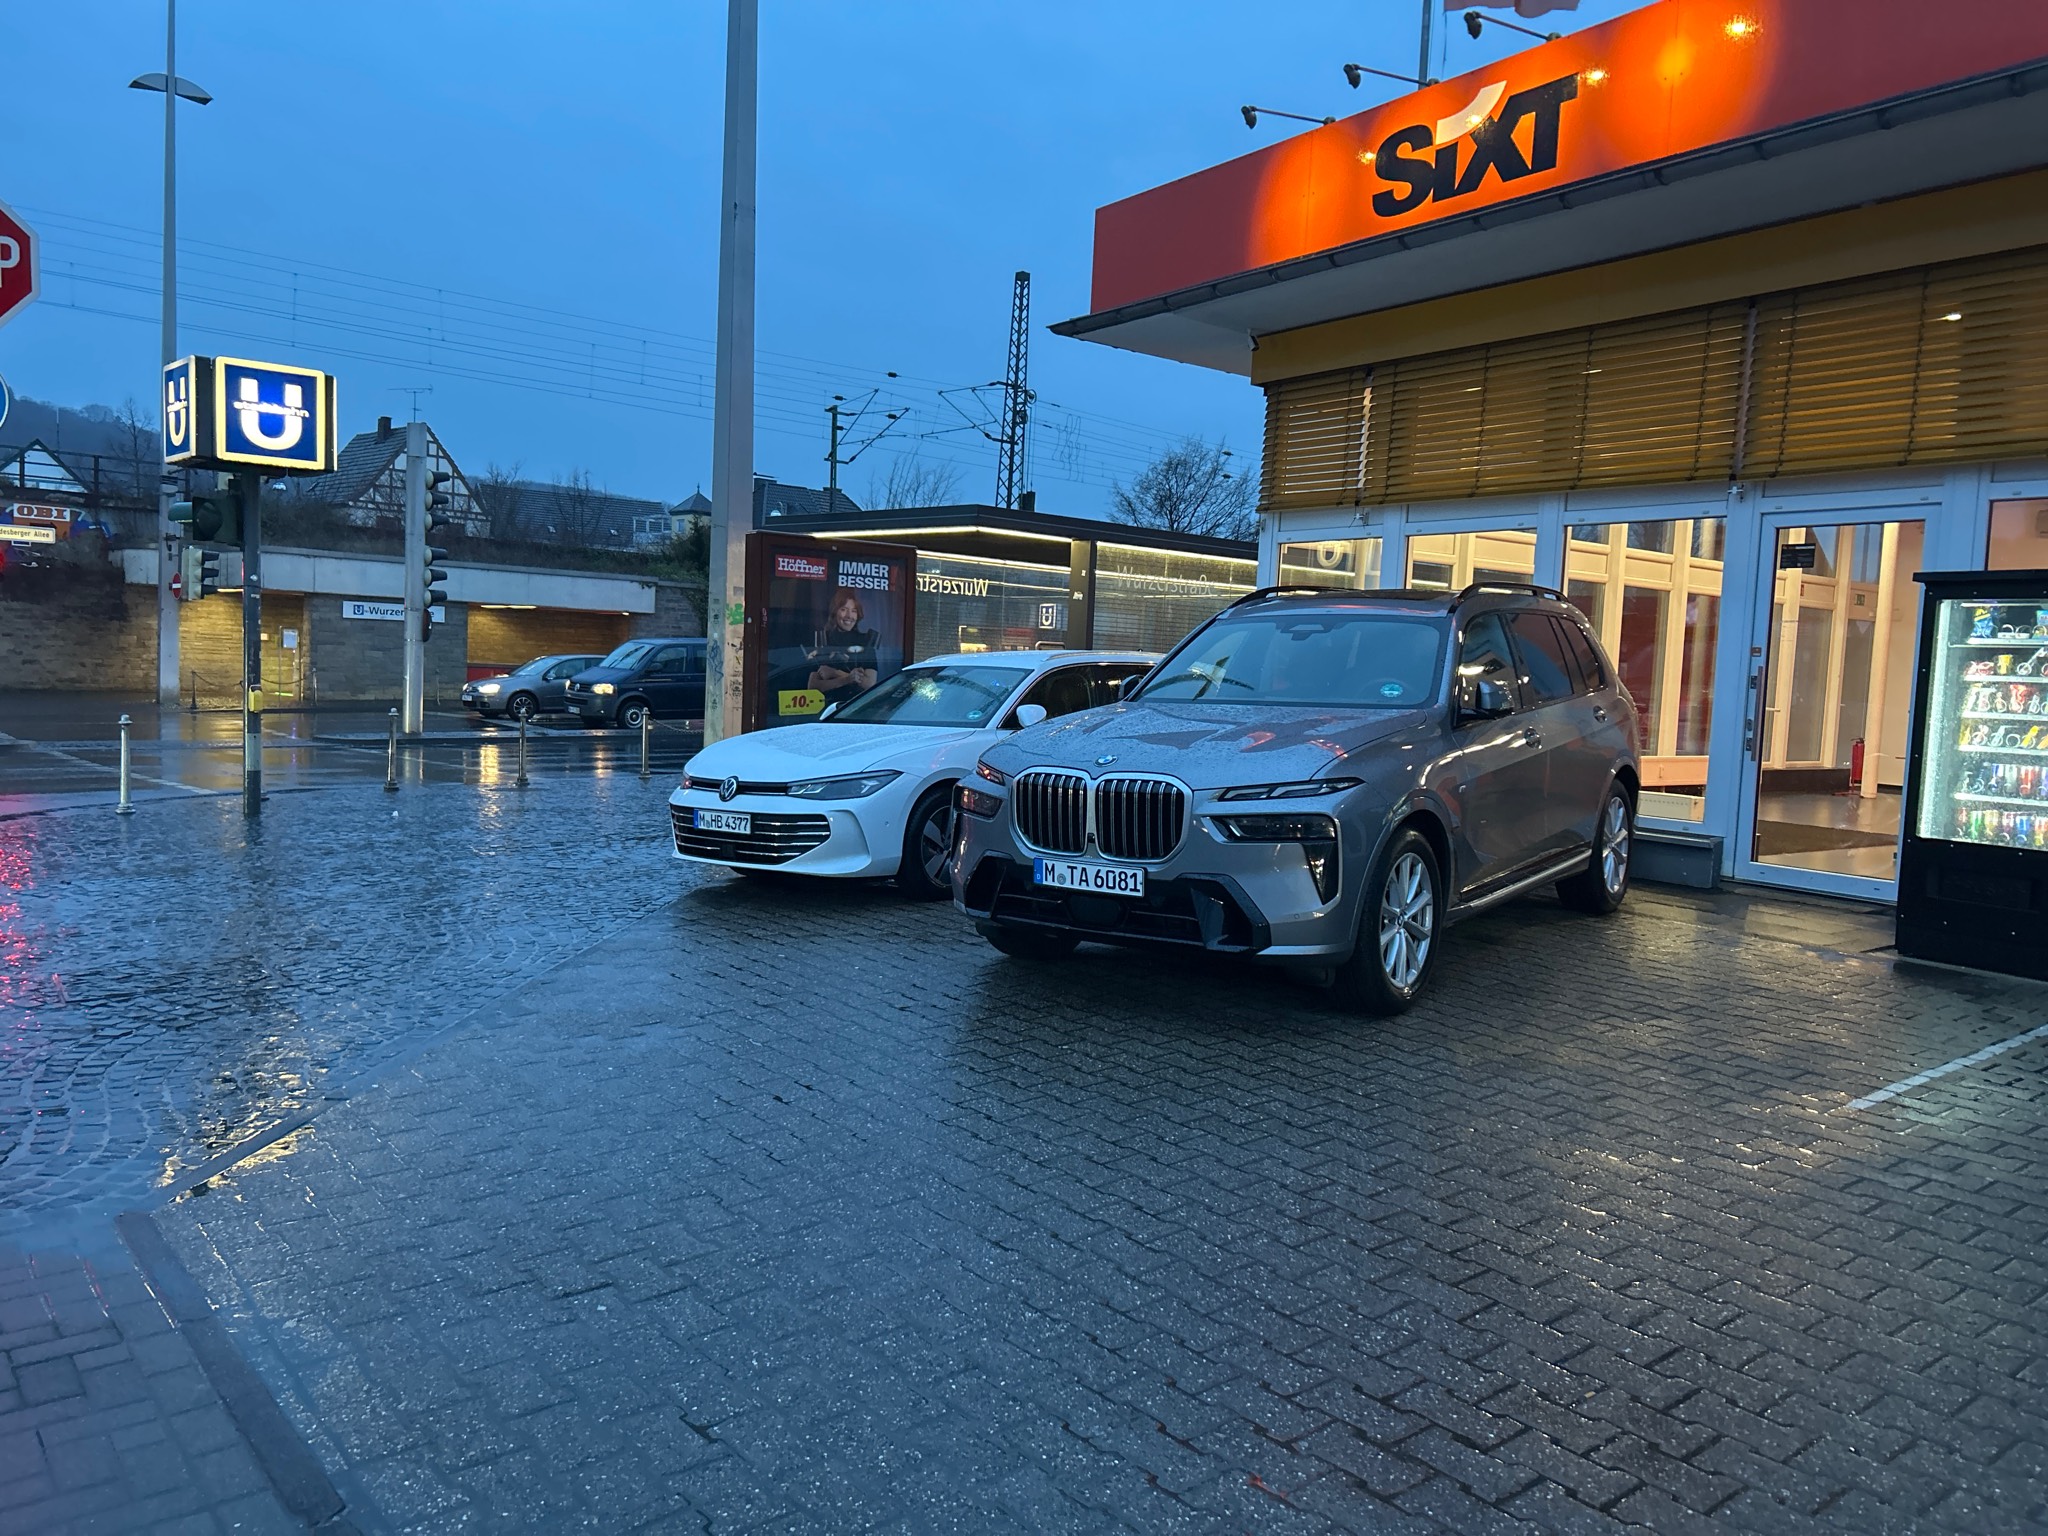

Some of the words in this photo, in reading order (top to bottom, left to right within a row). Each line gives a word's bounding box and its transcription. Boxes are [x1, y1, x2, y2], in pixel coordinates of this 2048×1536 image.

[16, 505, 67, 520] OBI
[34, 530, 50, 538] Allee
[777, 557, 825, 575] Höffner
[838, 560, 889, 578] IMMER
[699, 813, 706, 827] M
[710, 814, 723, 829] HB
[725, 816, 749, 832] 4377
[1044, 862, 1056, 883] M
[1067, 865, 1090, 887] TA
[1094, 868, 1141, 893] 6081
